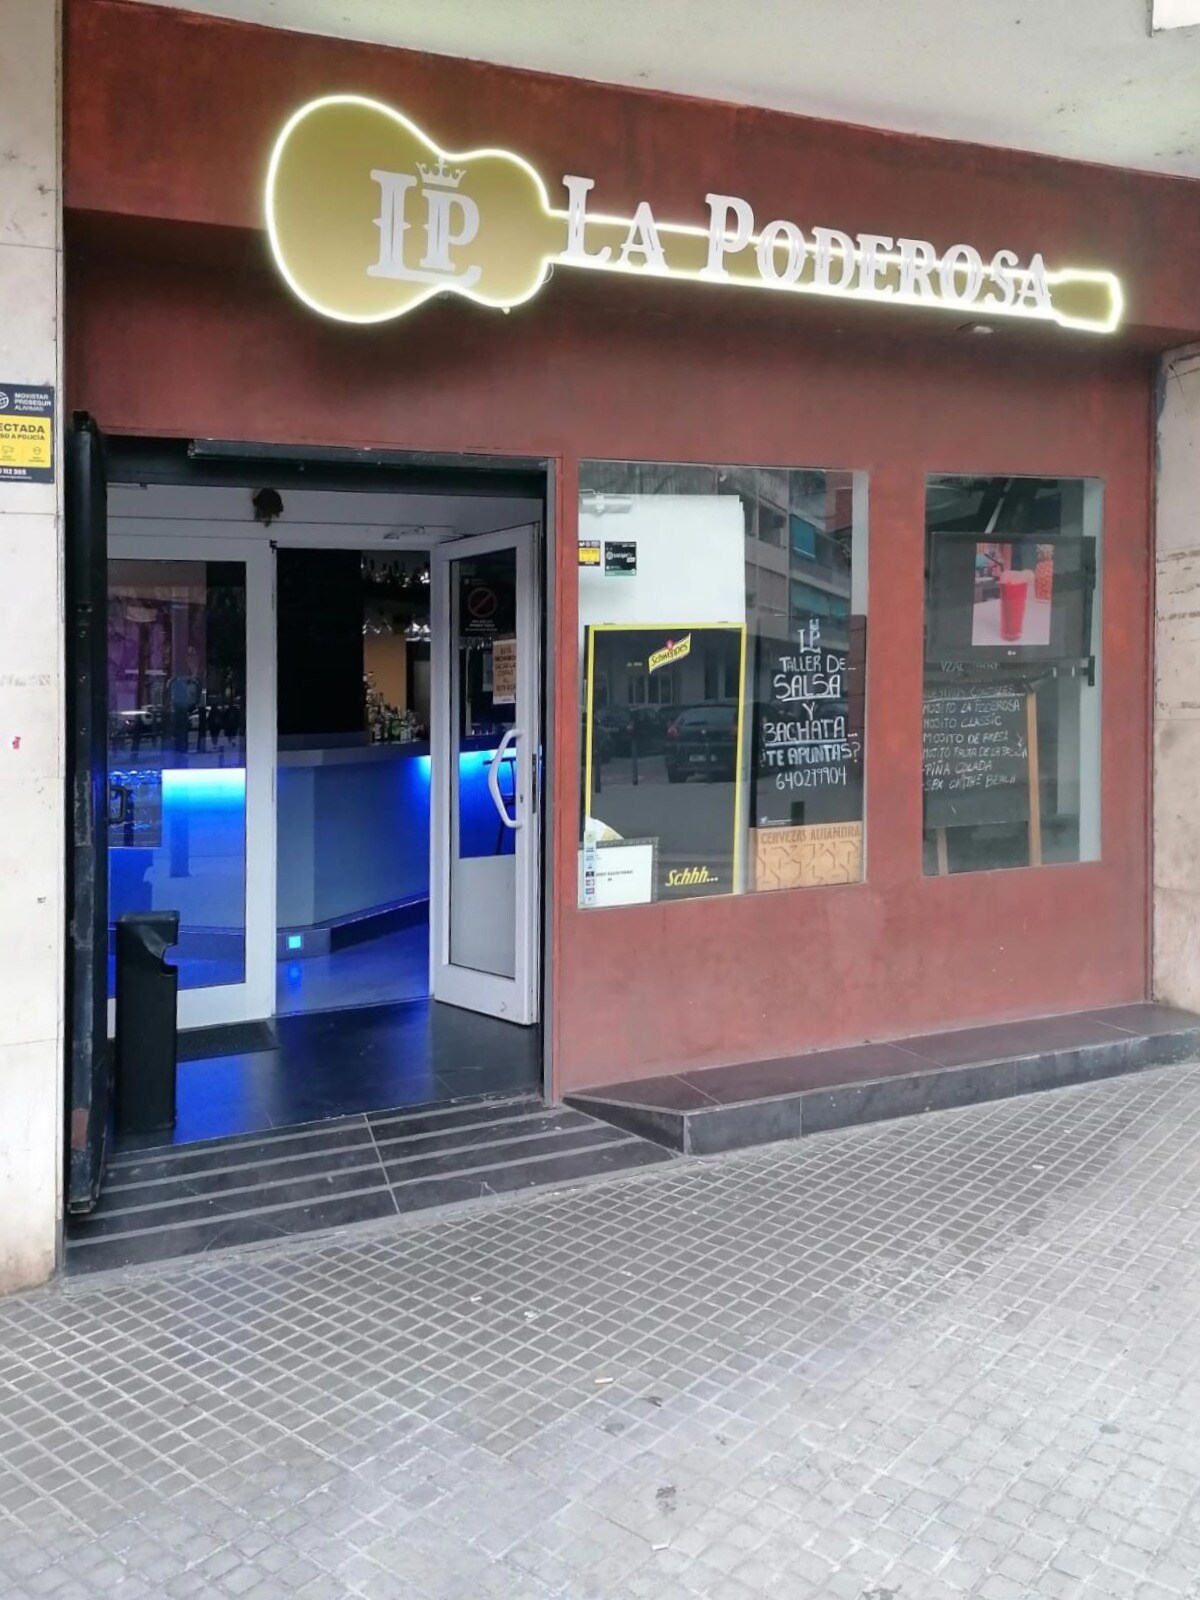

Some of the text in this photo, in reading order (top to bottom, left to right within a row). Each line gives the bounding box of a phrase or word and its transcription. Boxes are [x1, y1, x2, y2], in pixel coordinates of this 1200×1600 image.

[366, 168, 482, 288] LP
[559, 174, 1054, 313] LA PODEROSA
[14, 392, 49, 400] MOVISTAR
[14, 399, 52, 407] PROSEGUR
[650, 641, 688, 667] Schweppes
[779, 655, 822, 673] TALLER
[773, 673, 841, 700] SALSA
[802, 701, 816, 721] Y
[923, 716, 957, 729] MOJITO
[923, 732, 964, 744] MOJITO
[967, 732, 980, 745] DE
[955, 760, 993, 774] COLADA
[761, 829, 808, 845] CERVEZAS
[664, 865, 719, 887] Schhh...
